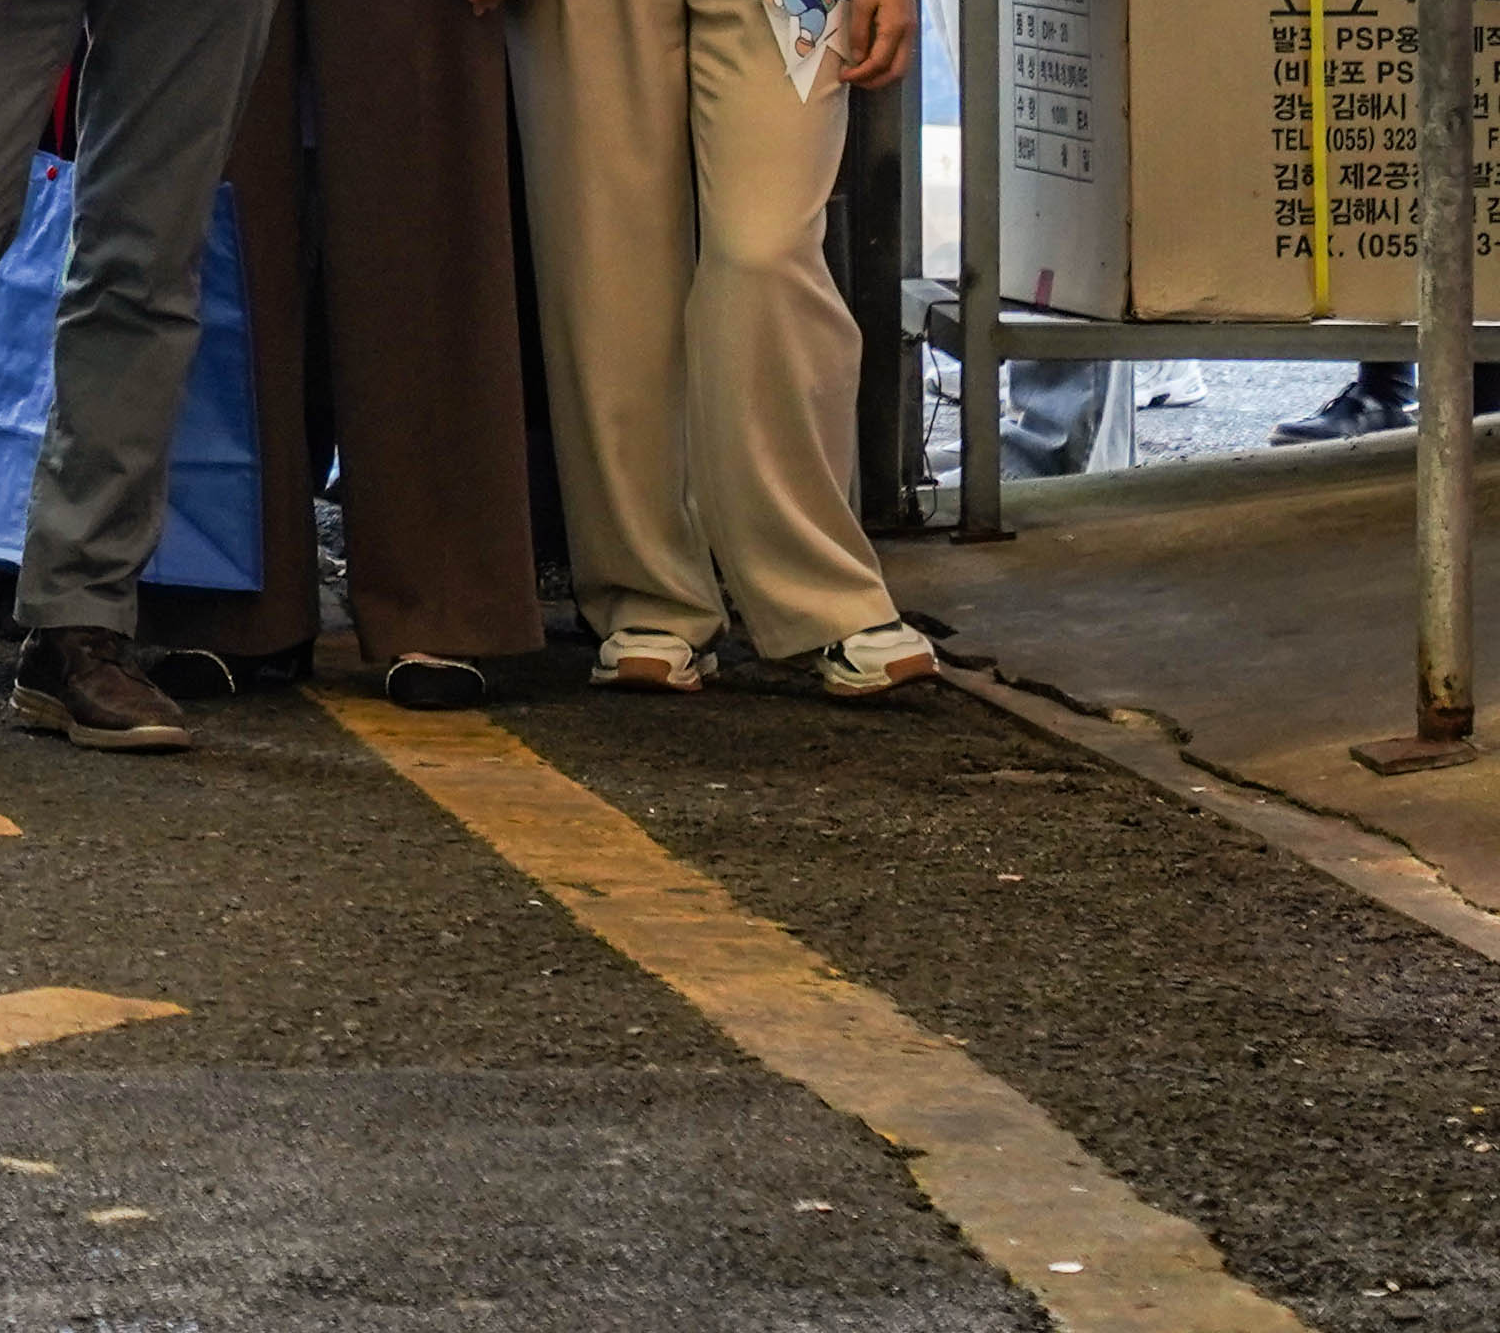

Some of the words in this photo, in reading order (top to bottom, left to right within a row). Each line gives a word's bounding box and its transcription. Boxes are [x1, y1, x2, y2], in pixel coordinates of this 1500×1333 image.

[1332, 93, 1408, 122] 김해시
[1326, 126, 1376, 154] (055)
[1339, 162, 1420, 192] 제2공
[1330, 197, 1401, 227] 김해시
